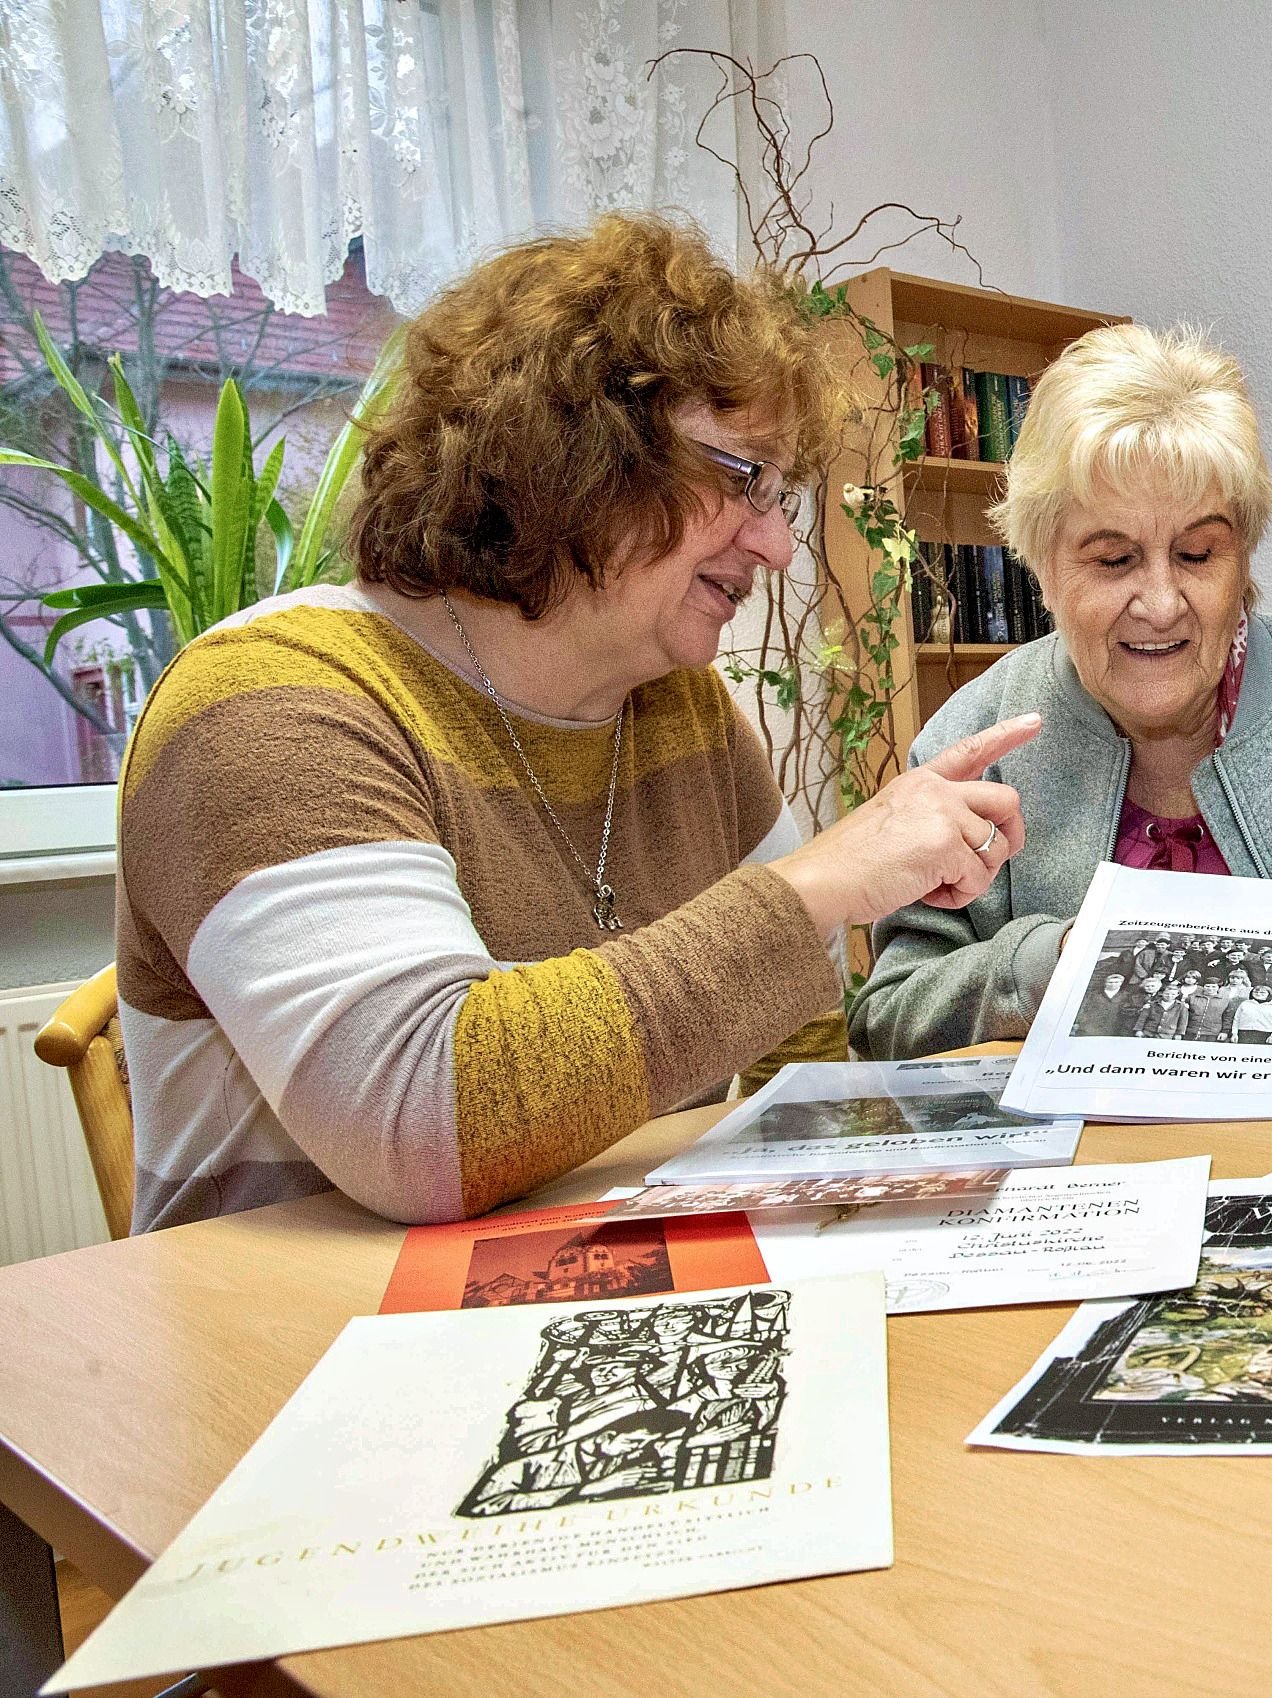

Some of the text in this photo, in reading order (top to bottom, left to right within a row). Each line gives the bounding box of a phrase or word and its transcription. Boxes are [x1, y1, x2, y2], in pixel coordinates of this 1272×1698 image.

[1117, 919, 1237, 933] Zeitzeugenberichte
[1146, 1050, 1206, 1061] Berichte
[1045, 1064, 1095, 1075] „Und
[1099, 1064, 1146, 1075] dann
[1151, 1067, 1210, 1079] waren
[1216, 1069, 1247, 1080] wir
[843, 1136, 963, 1150] geloben
[947, 1199, 1139, 1217] DIAMANTENEN
[938, 1207, 1140, 1226] KONFIRMATION
[957, 1235, 1105, 1249] Christuskirche
[988, 1230, 1033, 1243] Juni
[1040, 1227, 1084, 1237] 2022
[606, 1476, 842, 1521] URKUNDE
